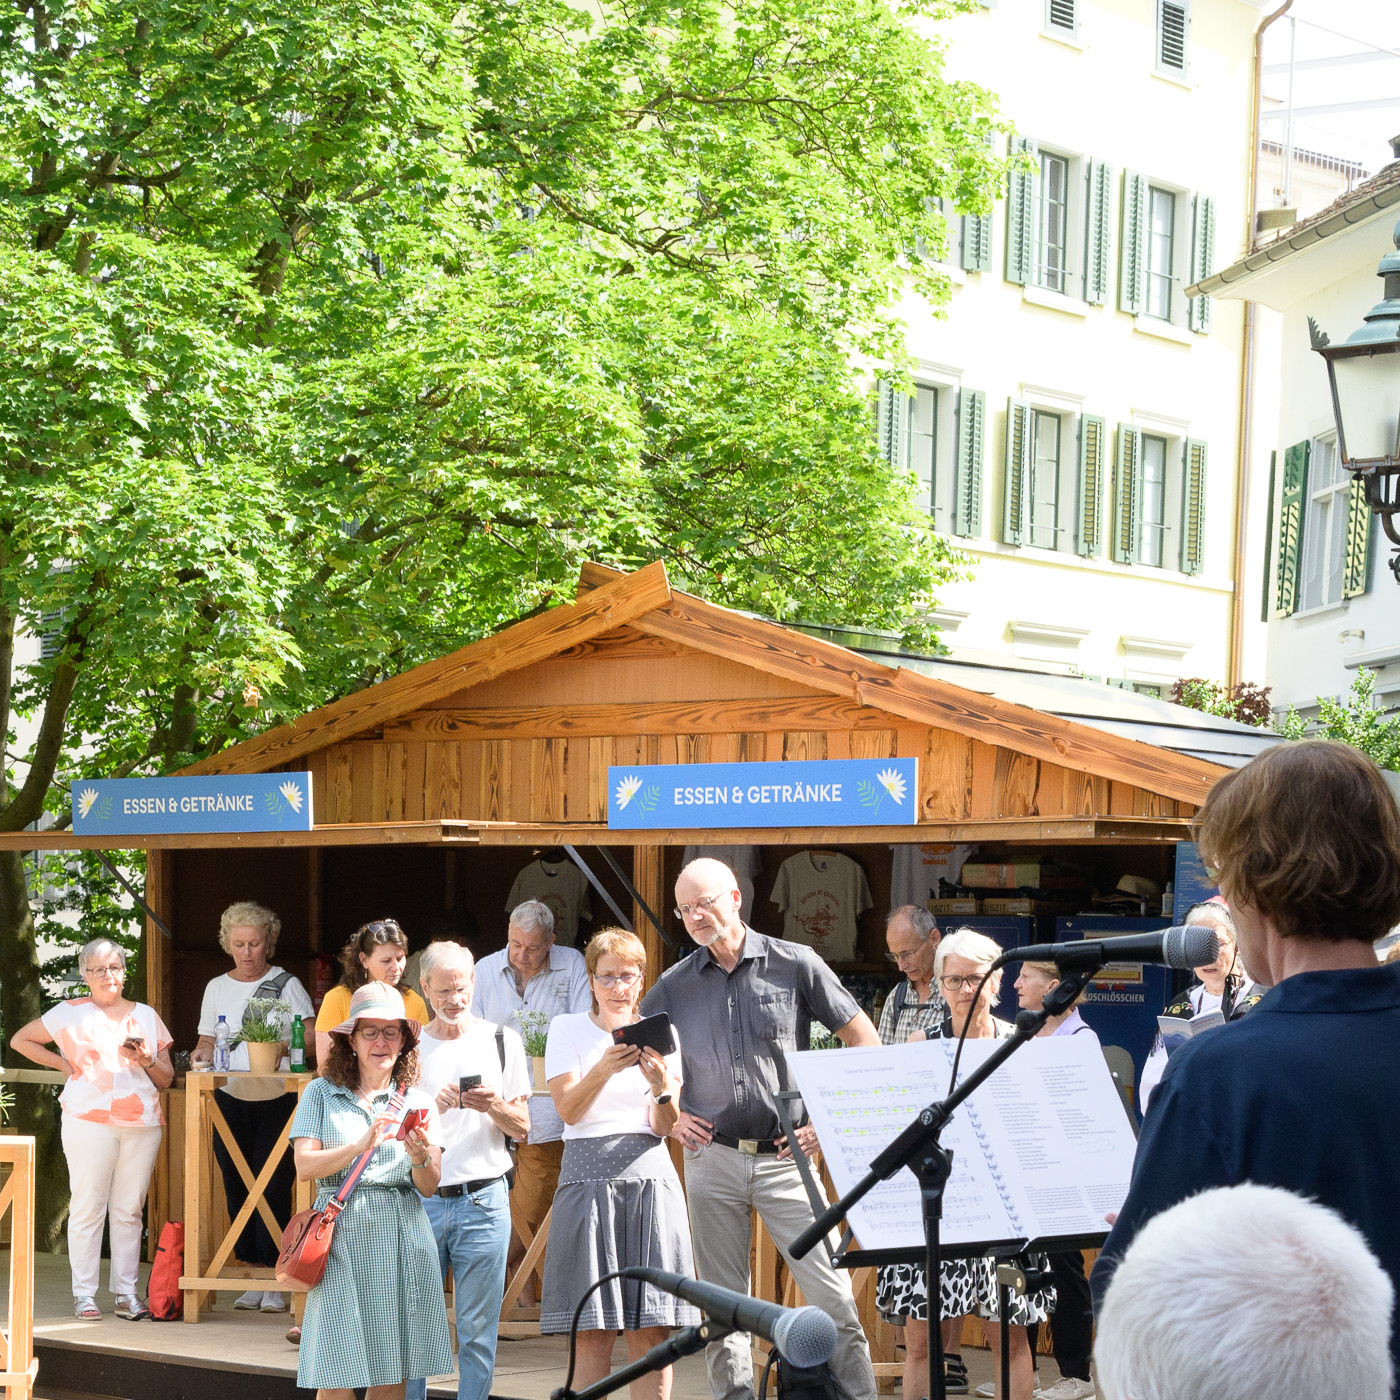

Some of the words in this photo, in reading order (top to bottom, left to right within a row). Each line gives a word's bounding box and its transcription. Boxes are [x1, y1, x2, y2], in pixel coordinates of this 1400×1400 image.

[123, 797, 166, 815] ESSEN
[168, 796, 178, 813] &
[180, 793, 254, 813] GETRÄNKE
[673, 786, 728, 806] ESSEN
[731, 785, 744, 804] &
[747, 781, 842, 804] GETRÄNKE
[1087, 991, 1145, 1003] DSCHLÖSSCHEN
